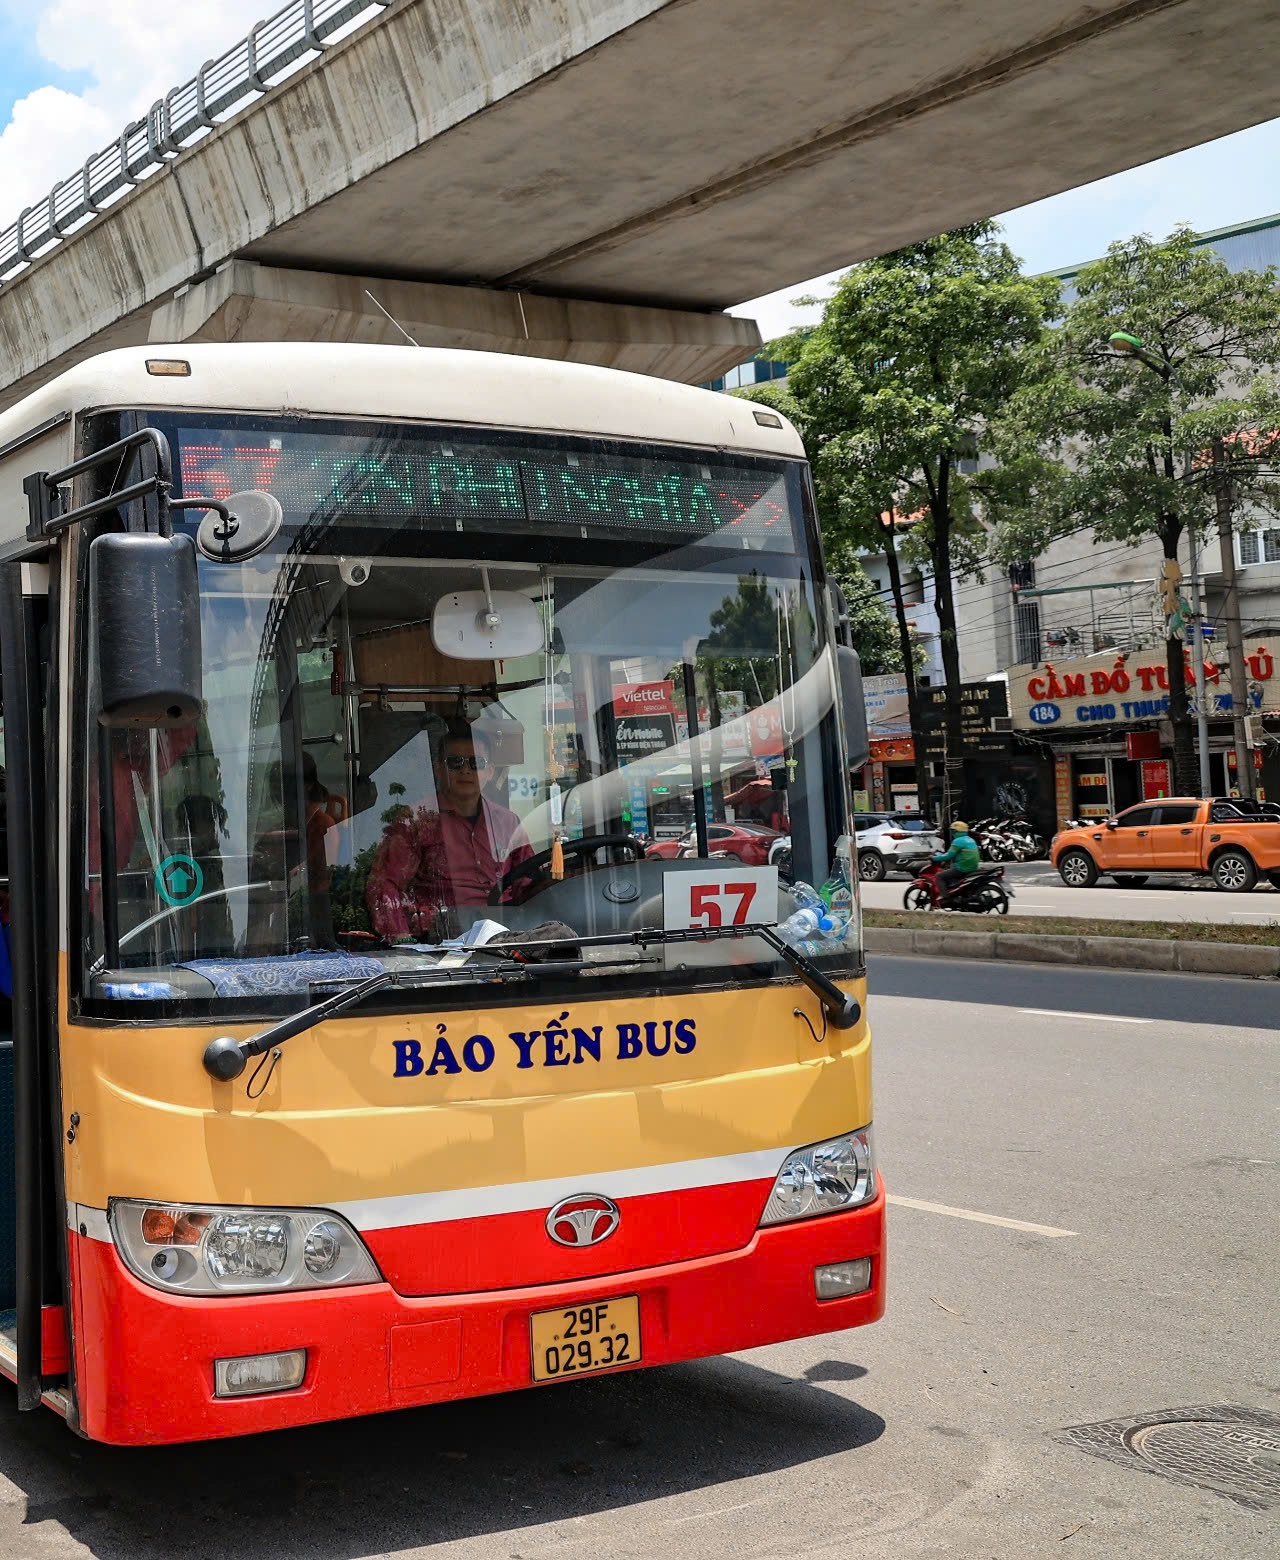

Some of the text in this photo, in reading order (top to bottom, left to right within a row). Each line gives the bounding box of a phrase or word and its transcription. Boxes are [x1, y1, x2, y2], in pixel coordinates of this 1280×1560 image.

[622, 688, 666, 703] viettel
[1033, 706, 1055, 721] 184
[1076, 703, 1116, 722] CHO
[509, 777, 538, 797] P39
[689, 883, 757, 943] 57
[392, 1011, 696, 1078] BẢO YẾN BUS
[563, 1305, 608, 1339] 29F
[545, 1333, 630, 1374] 029.32
